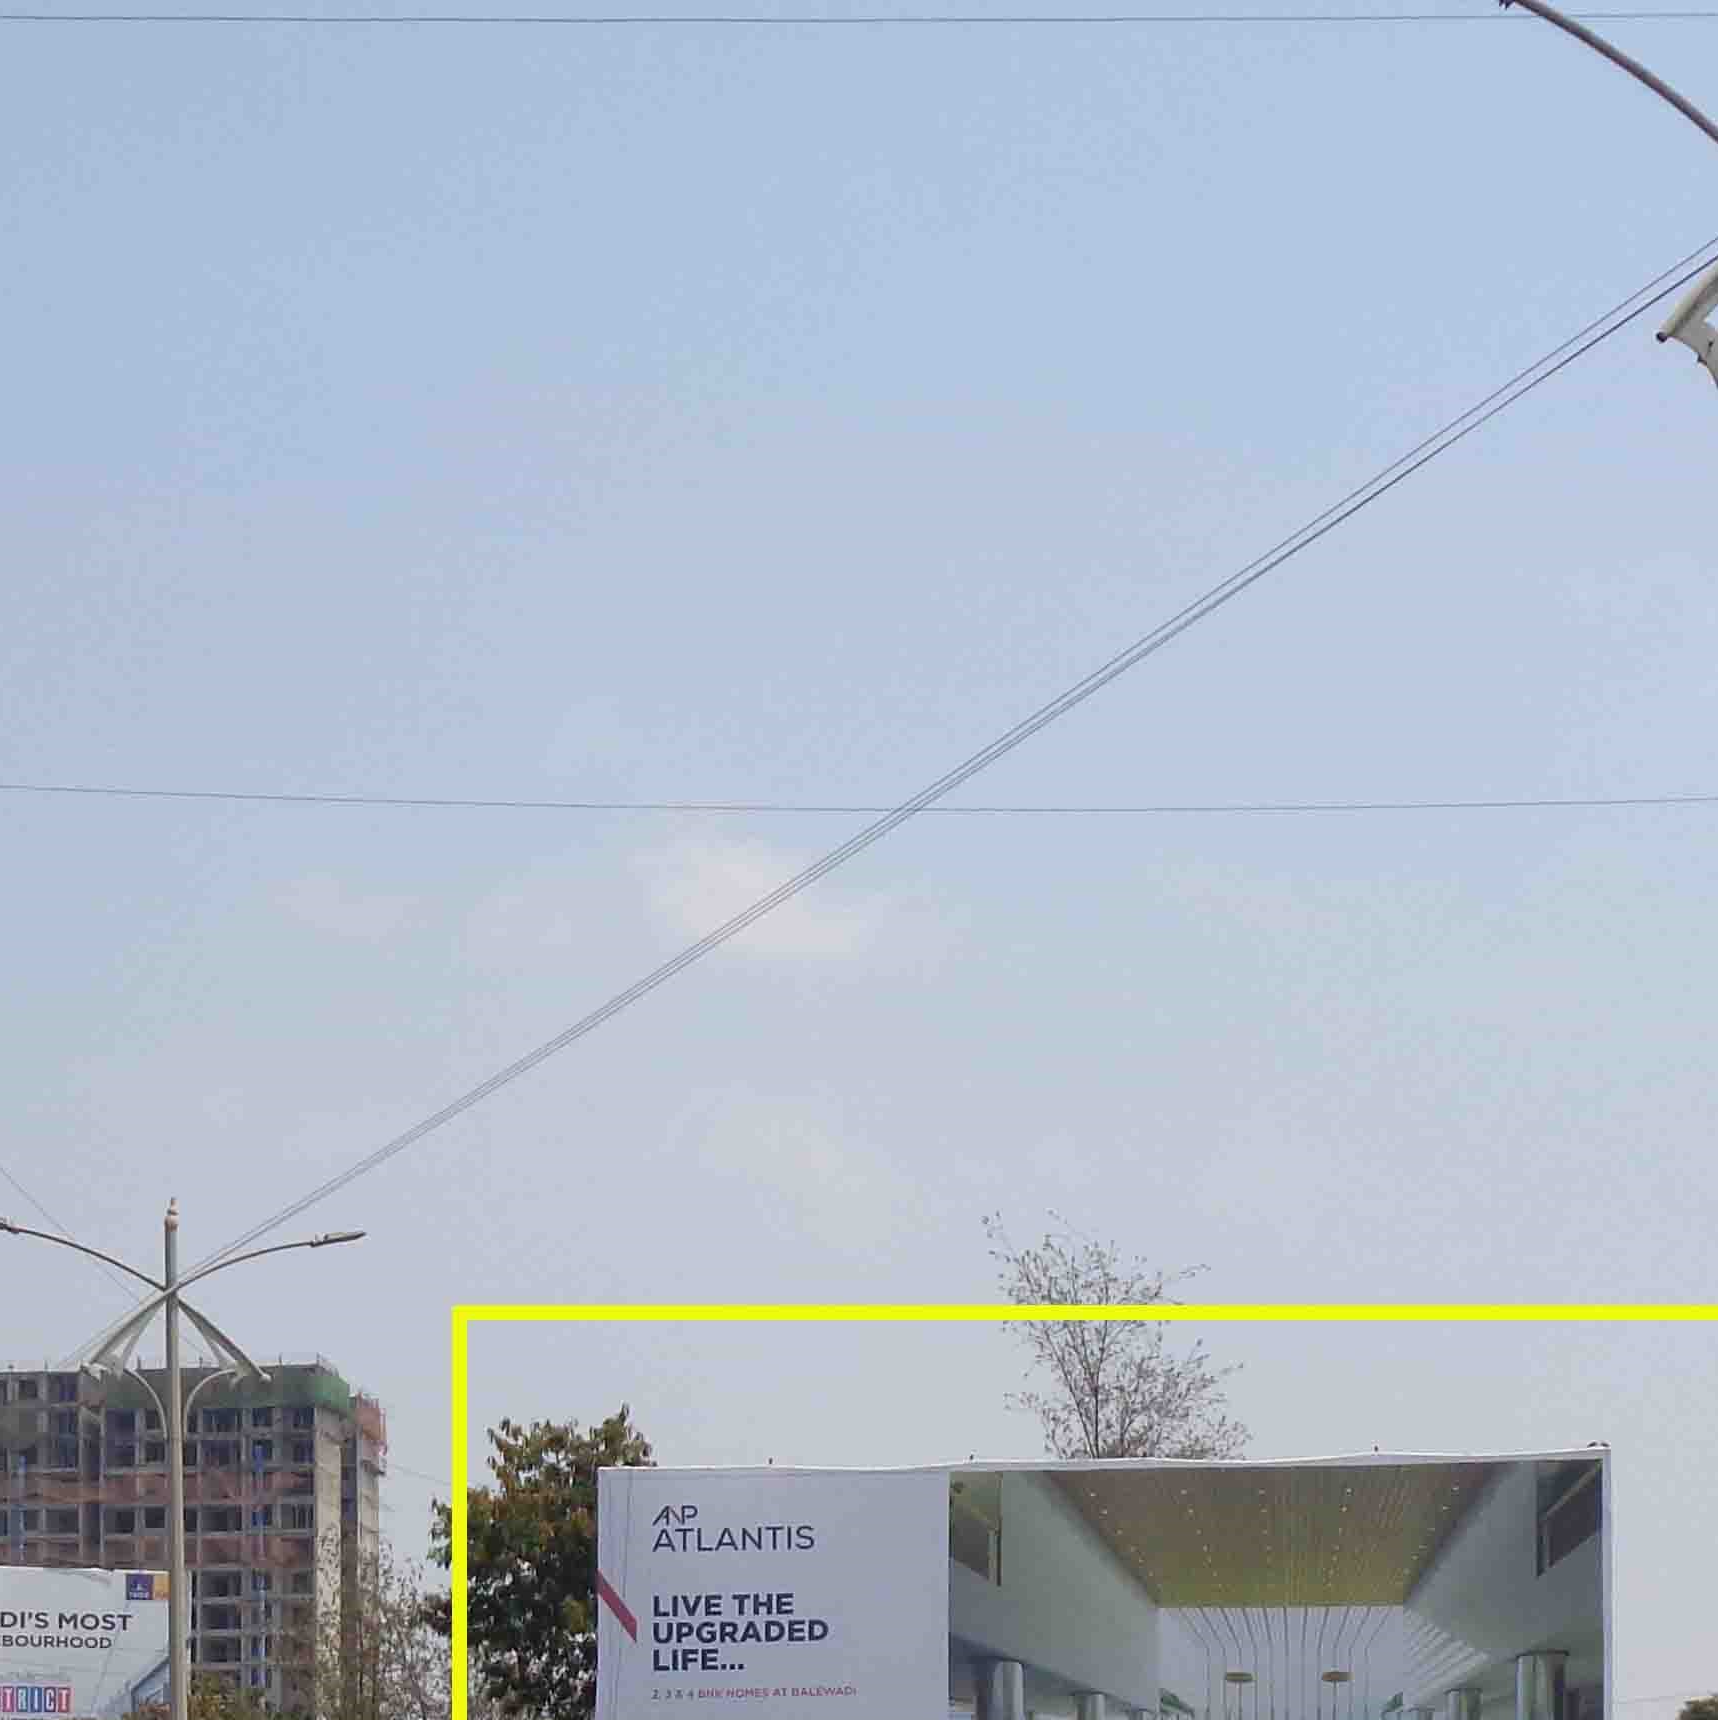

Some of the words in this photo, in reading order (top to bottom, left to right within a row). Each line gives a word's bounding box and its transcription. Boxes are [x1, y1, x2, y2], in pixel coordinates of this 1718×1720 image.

[653, 1525, 815, 1552] ATLANTIS
[653, 1595, 723, 1617] LIVE
[732, 1592, 794, 1615] THE
[58, 1612, 133, 1631] MOST
[653, 1620, 829, 1643] UPGRADED
[653, 1648, 744, 1671] LIFE...
